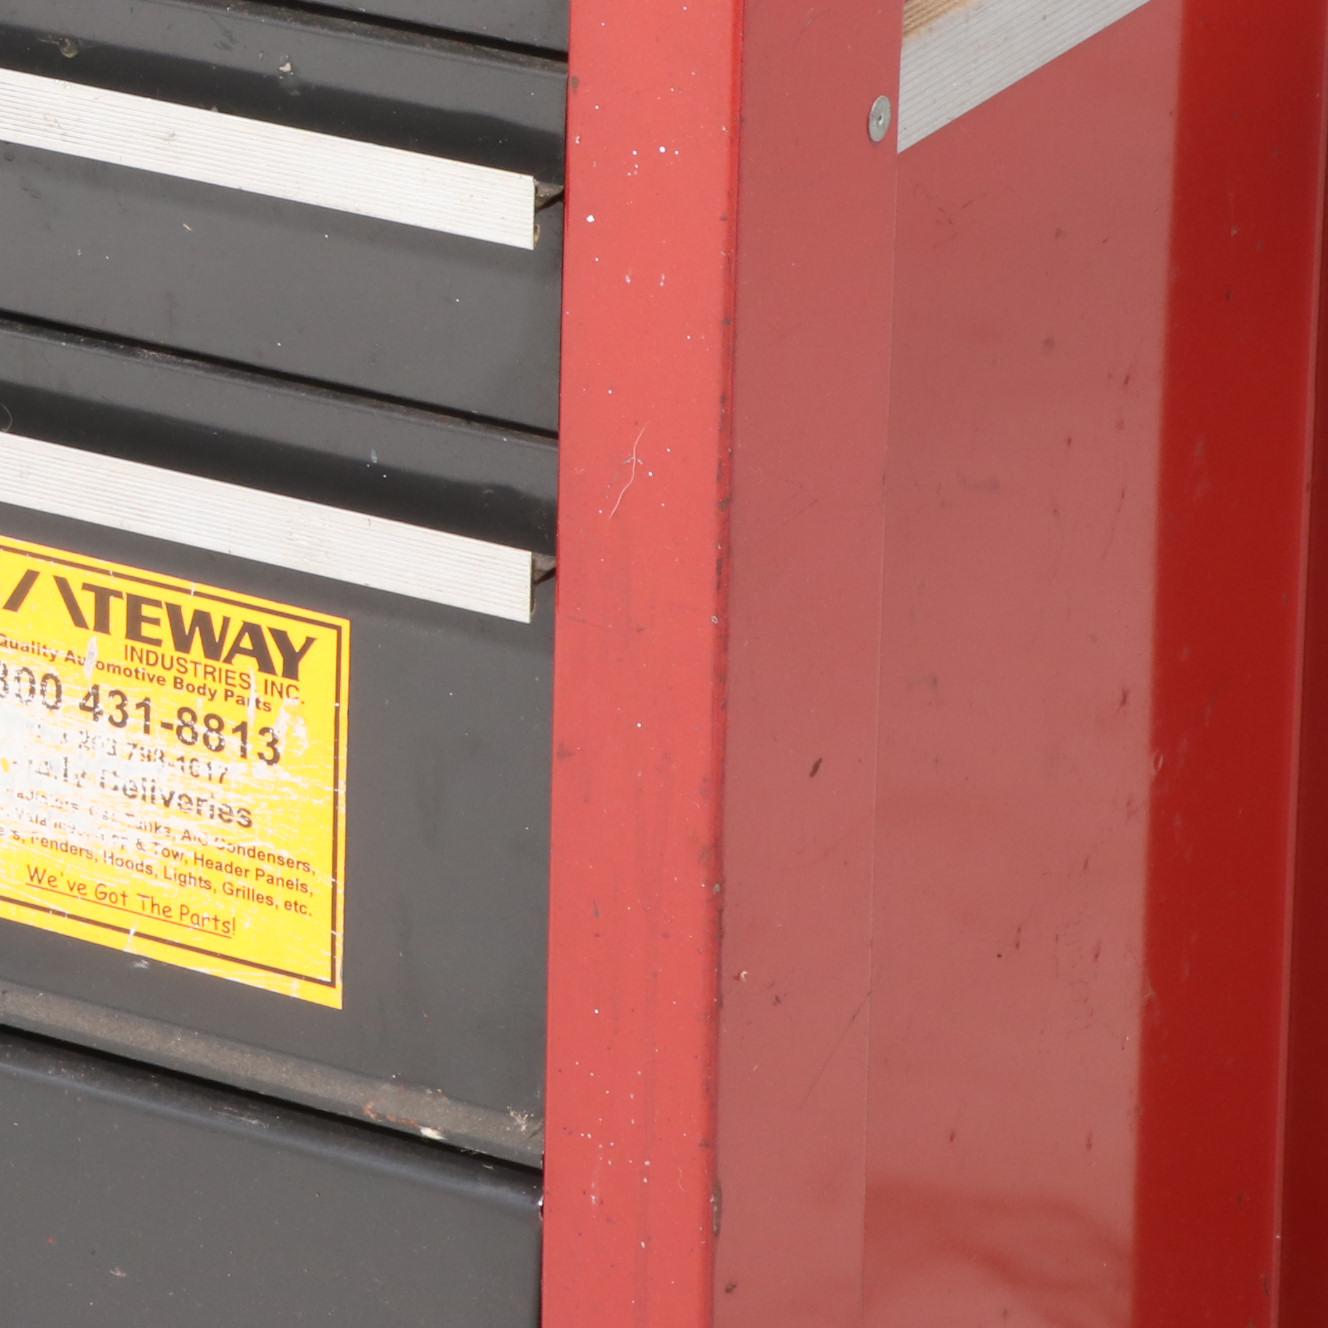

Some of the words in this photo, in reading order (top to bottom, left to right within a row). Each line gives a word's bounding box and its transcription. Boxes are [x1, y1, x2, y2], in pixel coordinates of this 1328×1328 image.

[64, 650, 167, 686] Auomotive
[174, 676, 217, 702] Body
[79, 683, 280, 766] 431-8813
[26, 863, 87, 896] We've
[94, 883, 129, 906] Got
[137, 892, 172, 919] The
[180, 904, 237, 936] Parts!
[103, 850, 158, 879] Hoods,
[164, 866, 217, 895] Lights,
[222, 881, 280, 910] Grilles,
[284, 899, 312, 917] etc.
[194, 851, 250, 878] Header
[256, 867, 314, 898] Panels,
